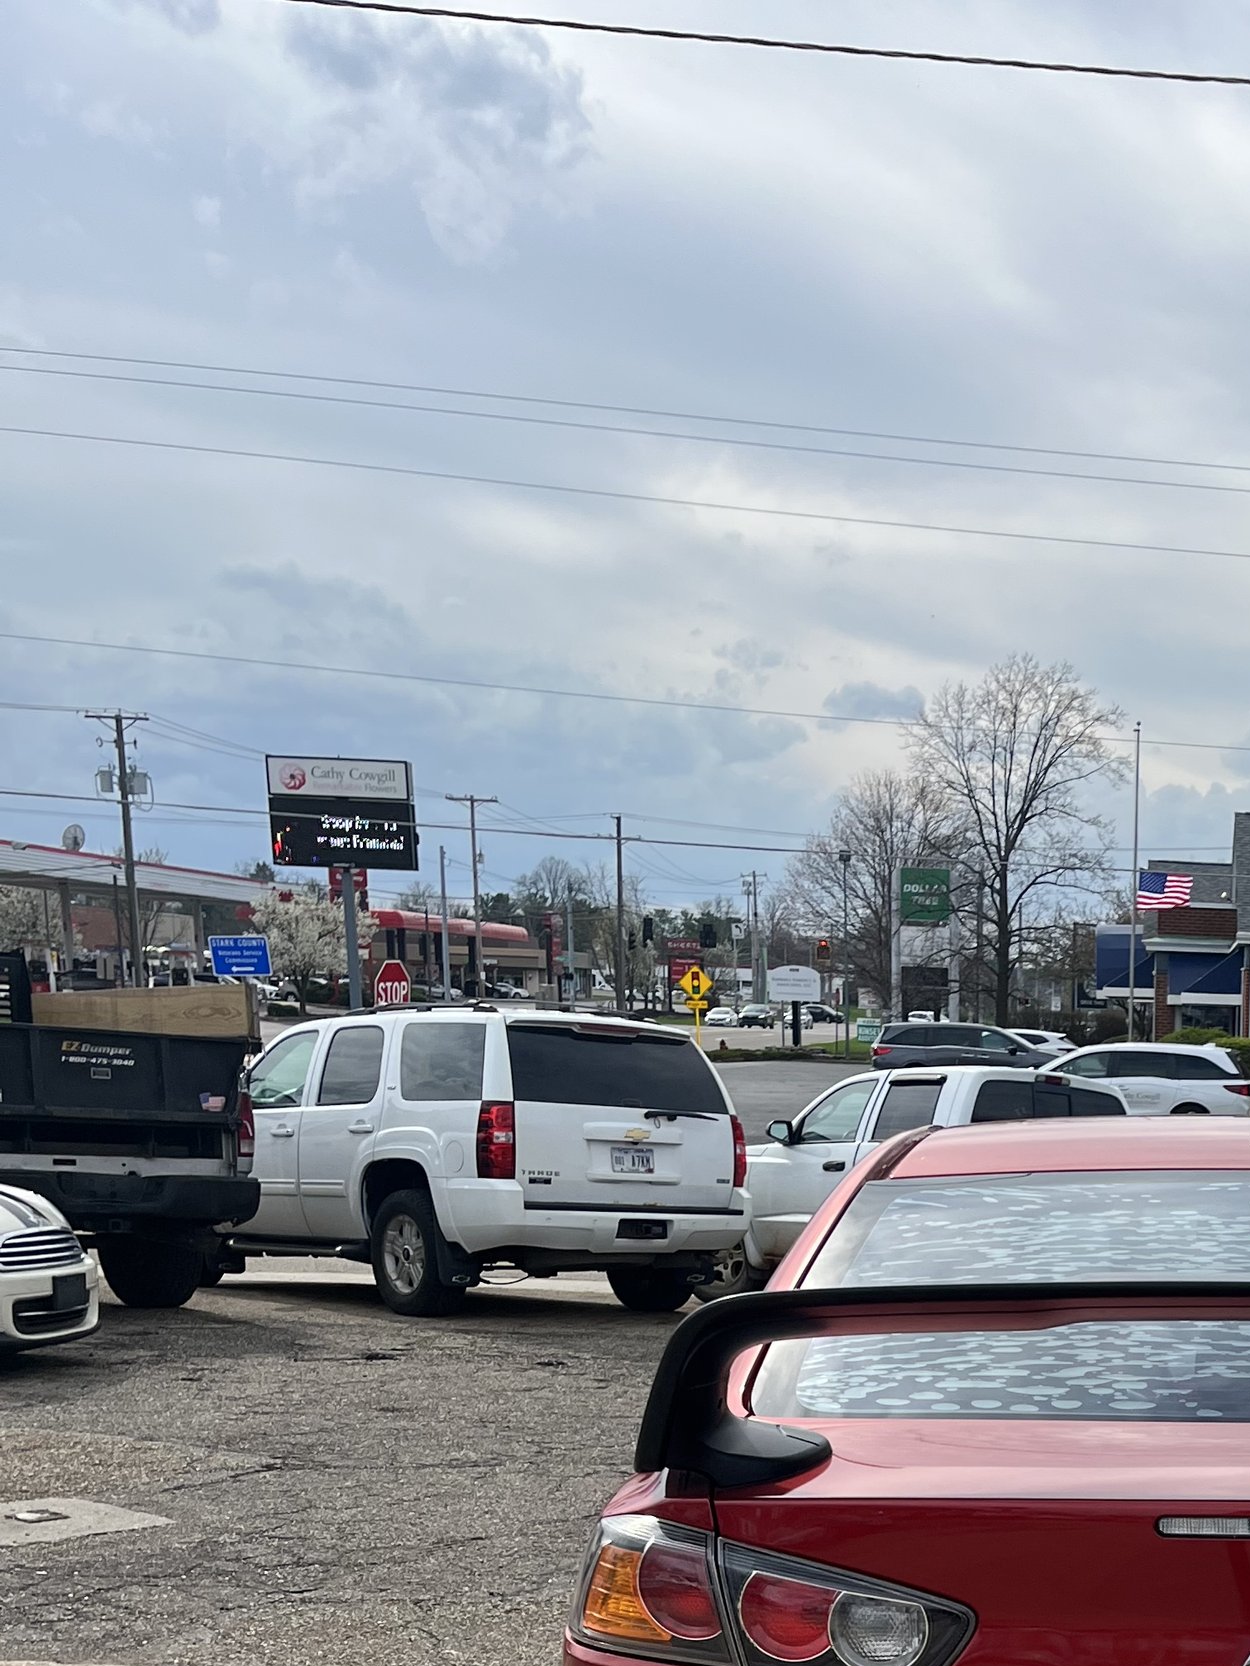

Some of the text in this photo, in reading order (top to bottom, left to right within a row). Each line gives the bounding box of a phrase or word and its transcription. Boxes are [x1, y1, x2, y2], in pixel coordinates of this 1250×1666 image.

[311, 765, 396, 785] Cathy Cowgill
[378, 982, 408, 1004] STOP
[81, 1043, 132, 1056] Dumper
